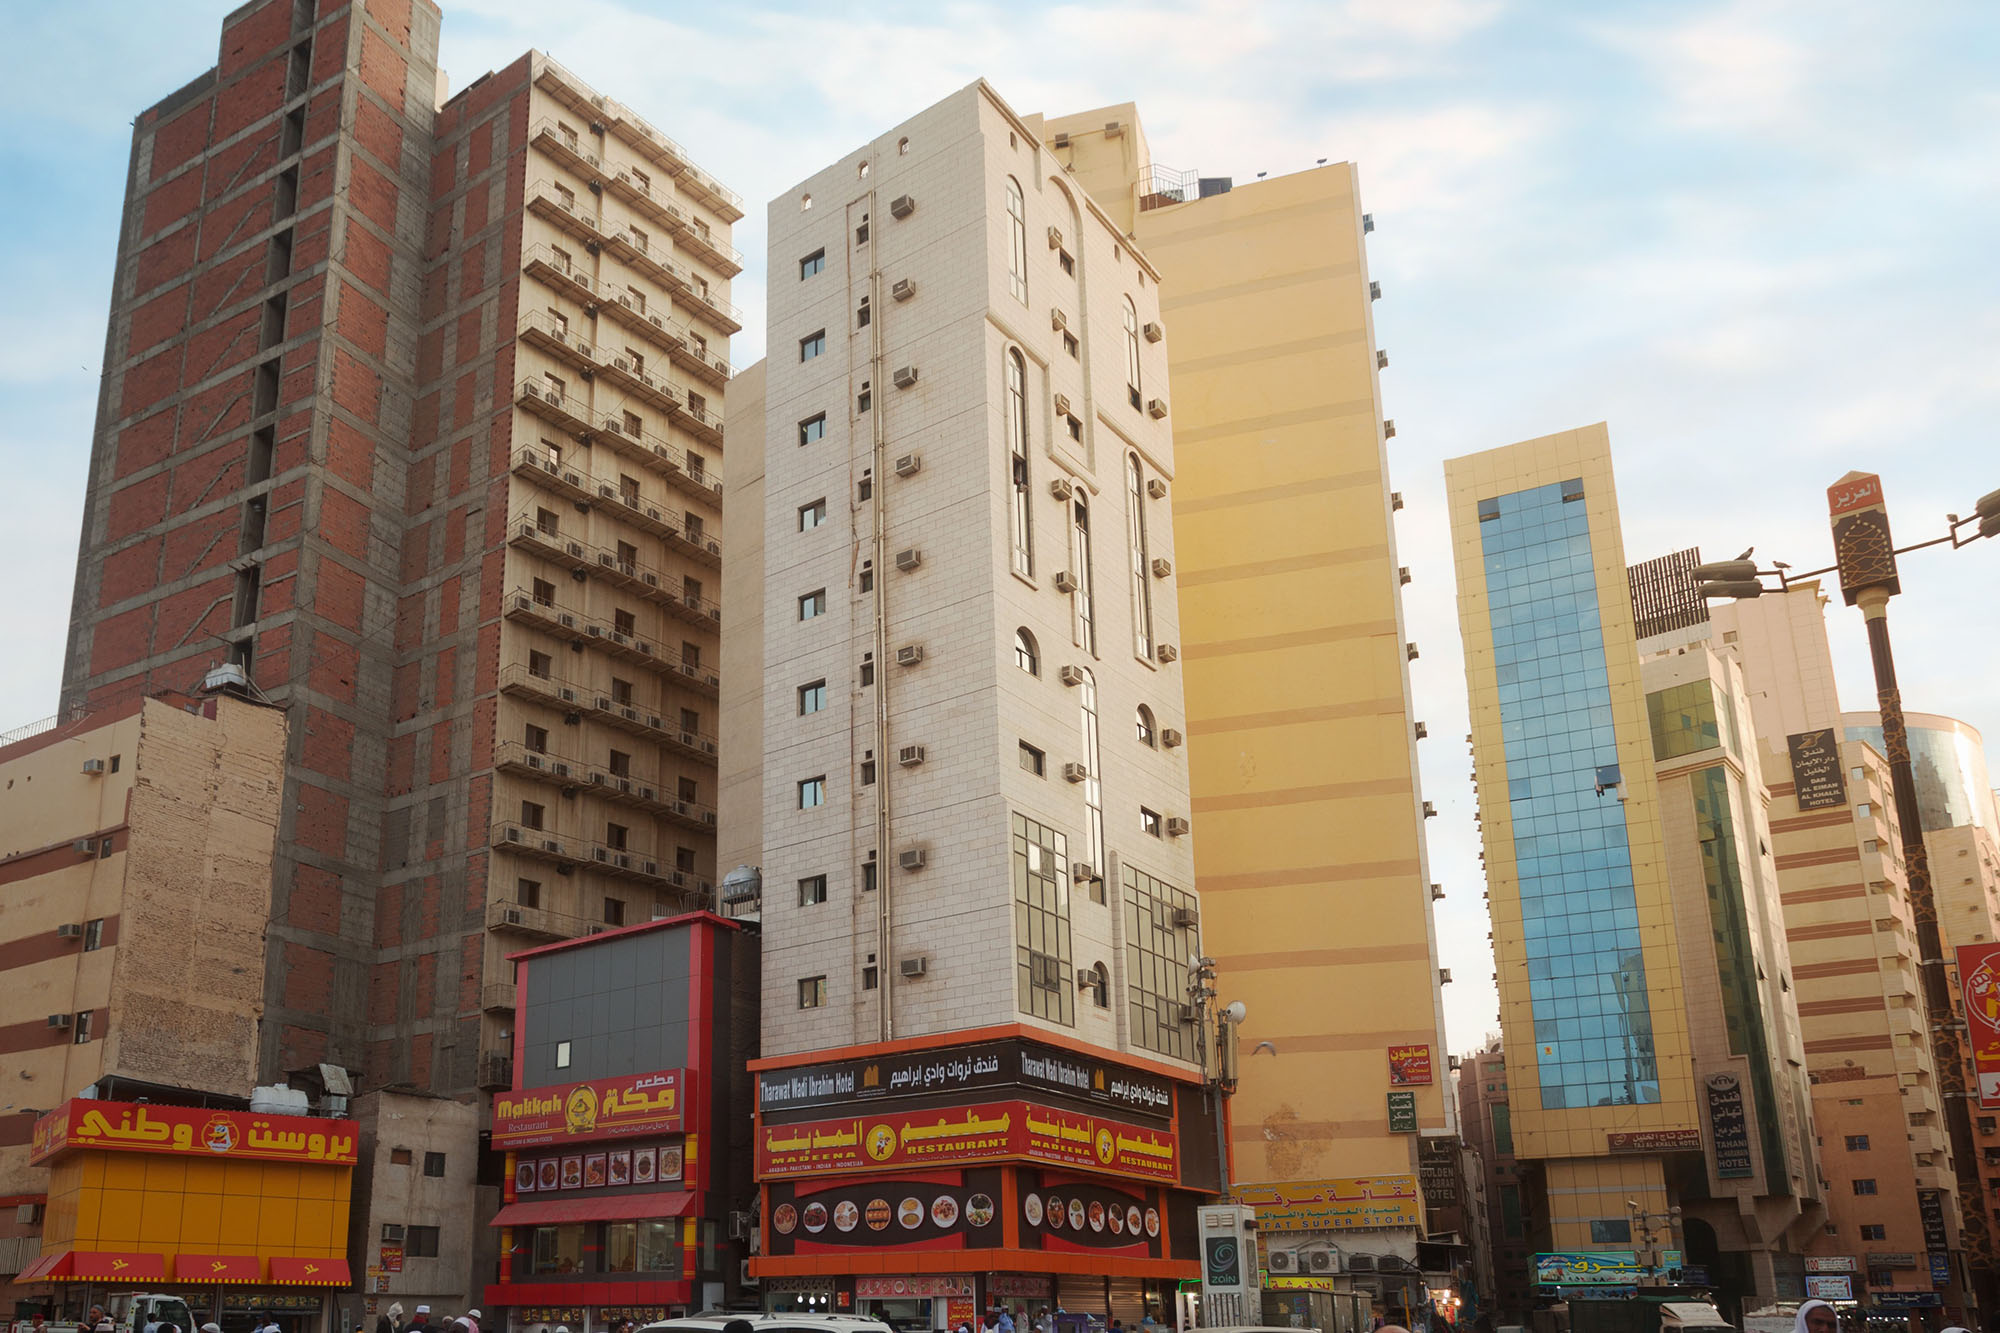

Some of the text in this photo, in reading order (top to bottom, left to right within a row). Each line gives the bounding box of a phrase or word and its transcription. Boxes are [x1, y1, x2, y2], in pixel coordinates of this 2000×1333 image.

[1834, 480, 1876, 508] العزيز
[1802, 747, 1824, 758] فندق
[1824, 756, 1834, 764] دار
[1804, 766, 1830, 776] الخليل
[1813, 782, 1838, 791] EIMAN
[1813, 790, 1841, 798] KHALIL
[1809, 798, 1836, 806] HOTEL
[1390, 1047, 1428, 1061] صالون
[890, 1055, 998, 1089] فندق ثروات وادي إبراهيم
[1021, 1051, 1090, 1089] Tharawat Wadi Ibrahim Hotel
[636, 1075, 674, 1092] مطعم
[760, 1080, 790, 1102] Tharawat
[792, 1076, 807, 1098] Wadi
[809, 1074, 834, 1096] Ibrahim
[836, 1070, 854, 1094] Hotel
[1130, 1084, 1142, 1104] وادي
[1142, 1085, 1155, 1106] ثروات
[1156, 1089, 1168, 1106] فندق
[1390, 1093, 1412, 1102] عصير
[1710, 1091, 1740, 1106] فندق
[498, 1094, 562, 1120] Makkah
[602, 1088, 675, 1117] مكة
[1390, 1101, 1412, 1112] قصب
[1392, 1112, 1414, 1121] السكر
[1713, 1106, 1742, 1122] تهاني
[508, 1120, 548, 1132] Restaurant
[766, 1108, 1010, 1155] مطعم المدينة
[1026, 1106, 1174, 1160] مطعم المدينة
[1714, 1123, 1744, 1138] الحرمين
[76, 1108, 352, 1160] بروست وطني
[1633, 1131, 1698, 1142] فندق تاج الخليل
[907, 1138, 1008, 1154] RESTAURANT
[1030, 1139, 1091, 1156] MADEENA
[1716, 1140, 1747, 1149] TAHANI
[771, 1151, 857, 1164] MADEENA
[836, 1160, 863, 1168] INDONESIAN
[1120, 1156, 1173, 1172] RESTAURANT
[1719, 1158, 1750, 1168] HOTEL
[1421, 1168, 1454, 1177] GOLDEN
[1421, 1178, 1455, 1188] AL-ABRAR
[1327, 1186, 1416, 1203] بقالة
[1424, 1189, 1456, 1200] HOTEL
[1256, 1210, 1304, 1220] والفواك
[1302, 1218, 1352, 1228] SUPER
[1364, 1215, 1416, 1224] STORE
